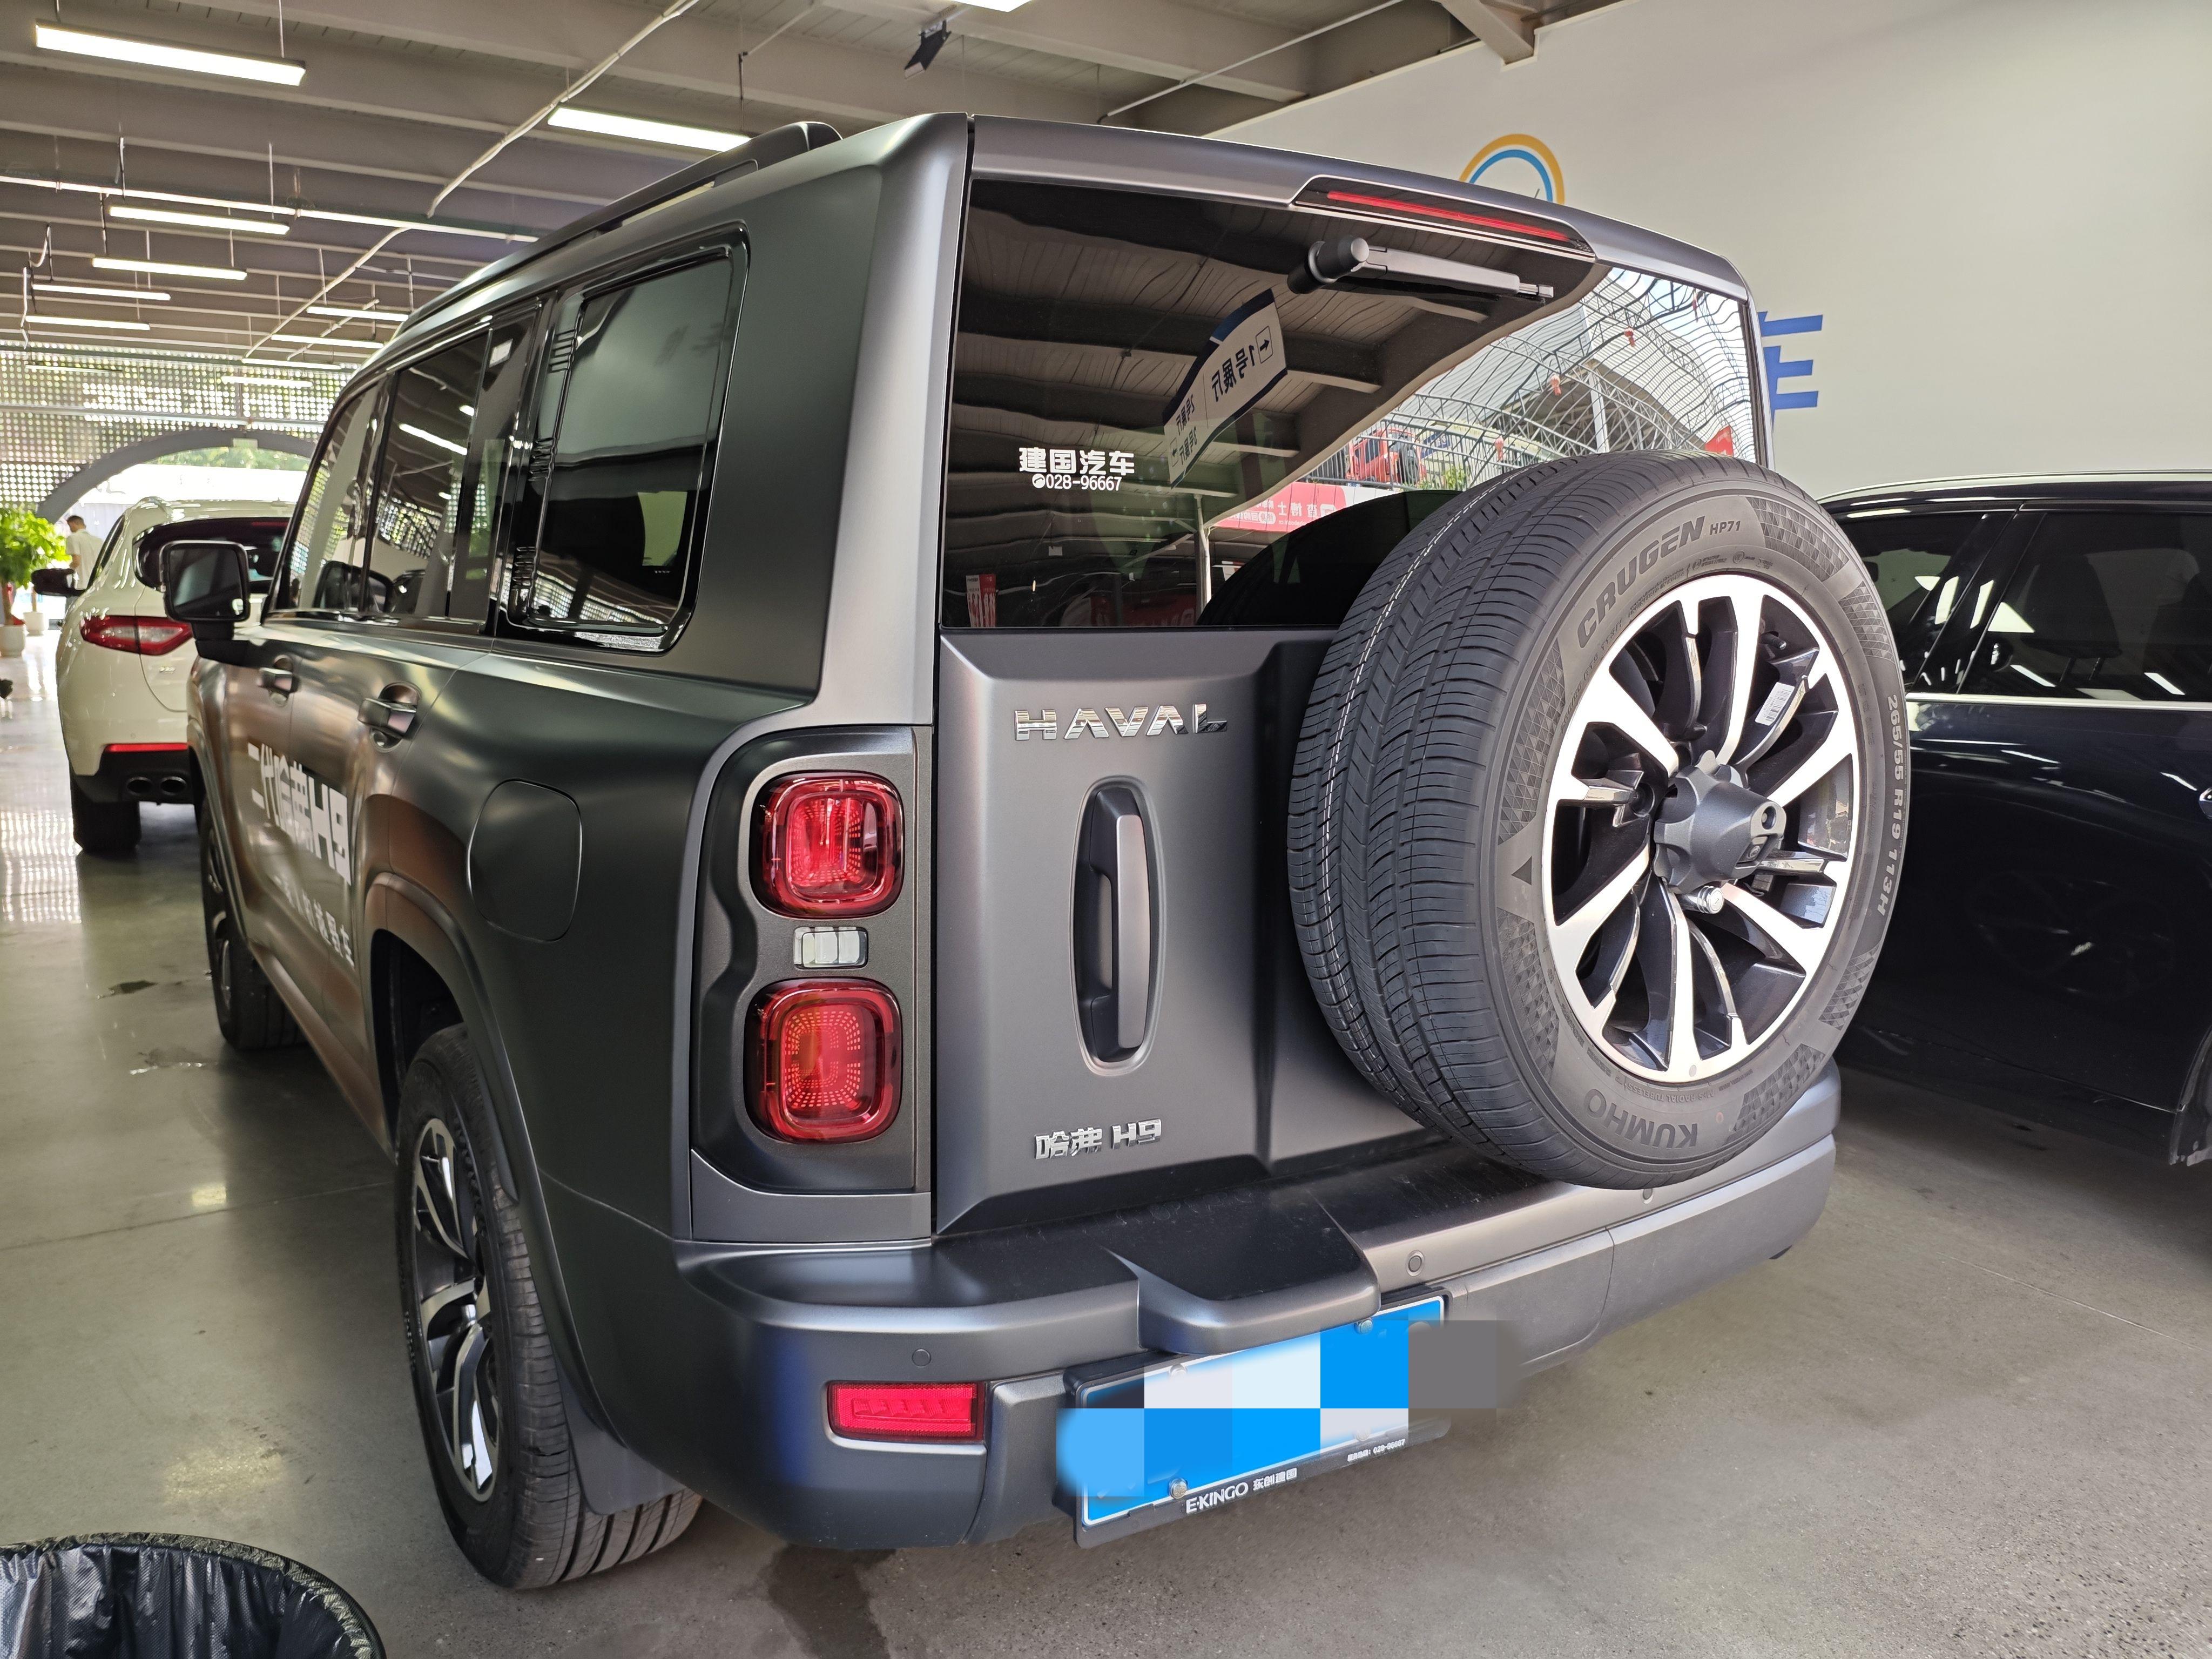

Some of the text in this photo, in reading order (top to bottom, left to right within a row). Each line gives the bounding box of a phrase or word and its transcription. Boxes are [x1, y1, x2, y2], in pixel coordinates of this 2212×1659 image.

[1019, 447, 1135, 476] 建国汽车
[1046, 474, 1122, 491] 028-96667
[1577, 516, 1705, 649] CRUGEN
[1709, 520, 1741, 535] HP71
[1014, 704, 1228, 740] HAVAL
[1878, 694, 1907, 916] 265/55 R19 113H
[1628, 1083, 1664, 1102] TUBELESS
[1666, 1094, 1696, 1103] RADIAL
[1584, 1088, 1698, 1149] KUMHO
[1034, 1118, 1162, 1159] 哈弗 H9
